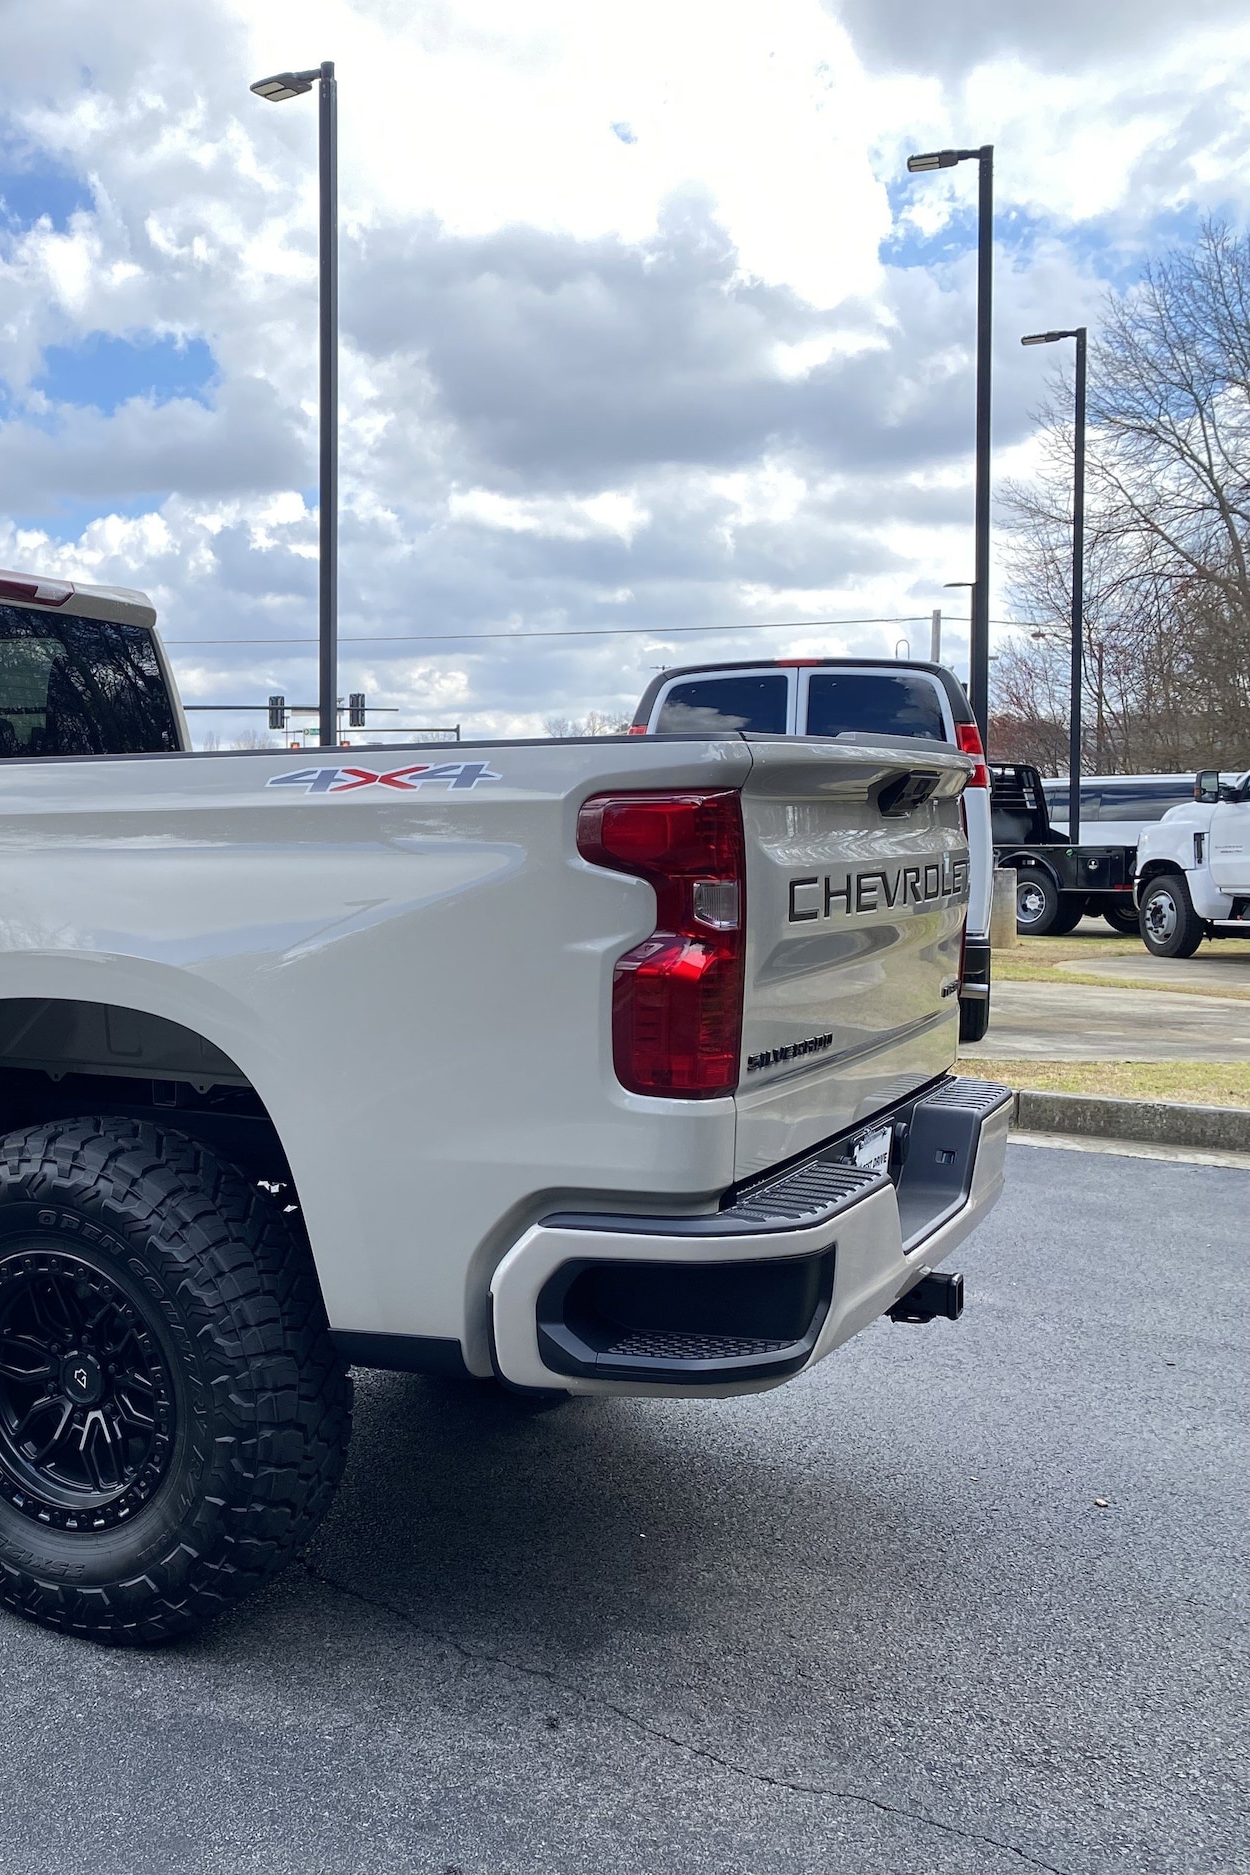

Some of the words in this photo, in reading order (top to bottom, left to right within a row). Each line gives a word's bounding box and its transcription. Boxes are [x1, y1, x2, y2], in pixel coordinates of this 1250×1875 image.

[266, 761, 502, 794] 4X4
[872, 1152, 888, 1168] DRIVE
[36, 1209, 126, 1255] OPEN
